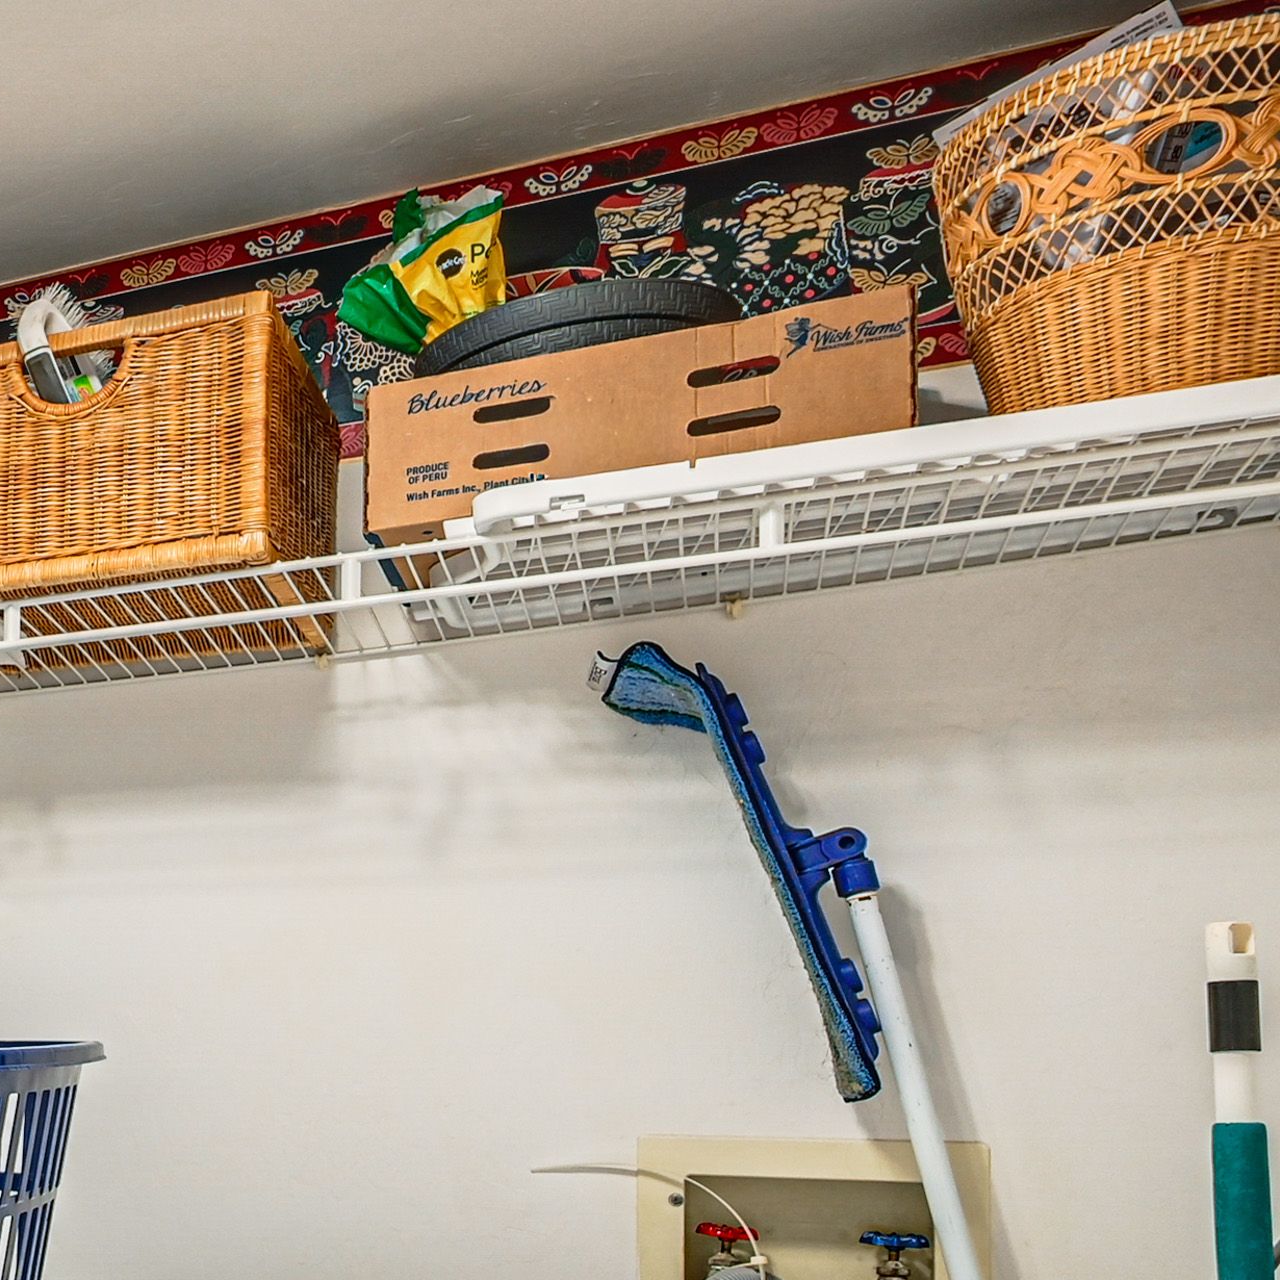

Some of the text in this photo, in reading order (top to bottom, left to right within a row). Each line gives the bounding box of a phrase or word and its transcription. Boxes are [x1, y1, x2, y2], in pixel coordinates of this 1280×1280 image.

[811, 326, 853, 348] Wish
[407, 379, 547, 415] Blueberries
[406, 461, 450, 477] PRODUCE
[408, 471, 448, 485] OF PERU
[406, 490, 429, 502] Wish
[431, 487, 460, 499] Farms
[483, 478, 509, 490] Plant
